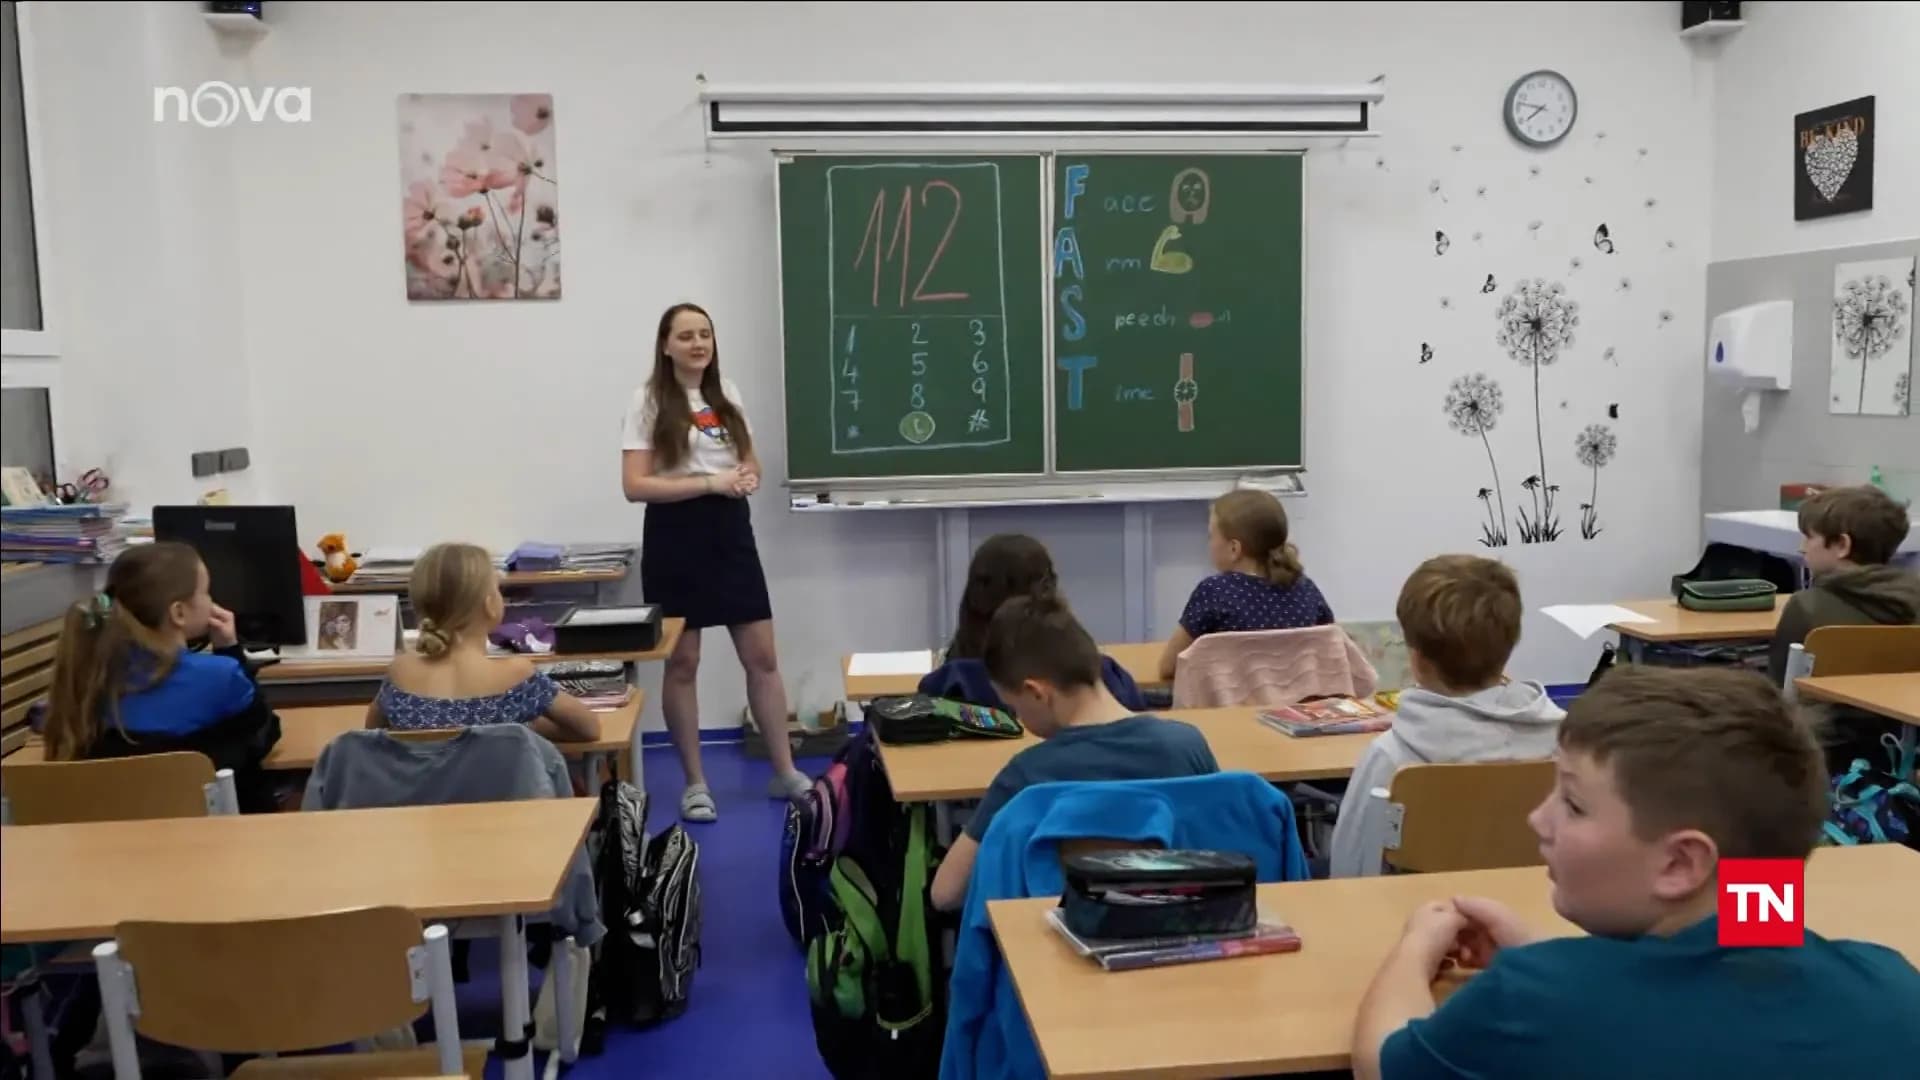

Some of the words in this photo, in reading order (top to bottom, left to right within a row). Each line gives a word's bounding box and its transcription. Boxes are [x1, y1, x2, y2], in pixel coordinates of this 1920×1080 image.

[854, 179, 970, 308] 112
[846, 324, 857, 353] 1
[911, 322, 929, 345] 2
[969, 319, 987, 347] 3
[842, 357, 859, 385] 4
[911, 351, 929, 376] 5
[972, 350, 990, 374] 6
[841, 389, 862, 412] 7
[911, 383, 926, 409] 8
[971, 376, 987, 403] 9
